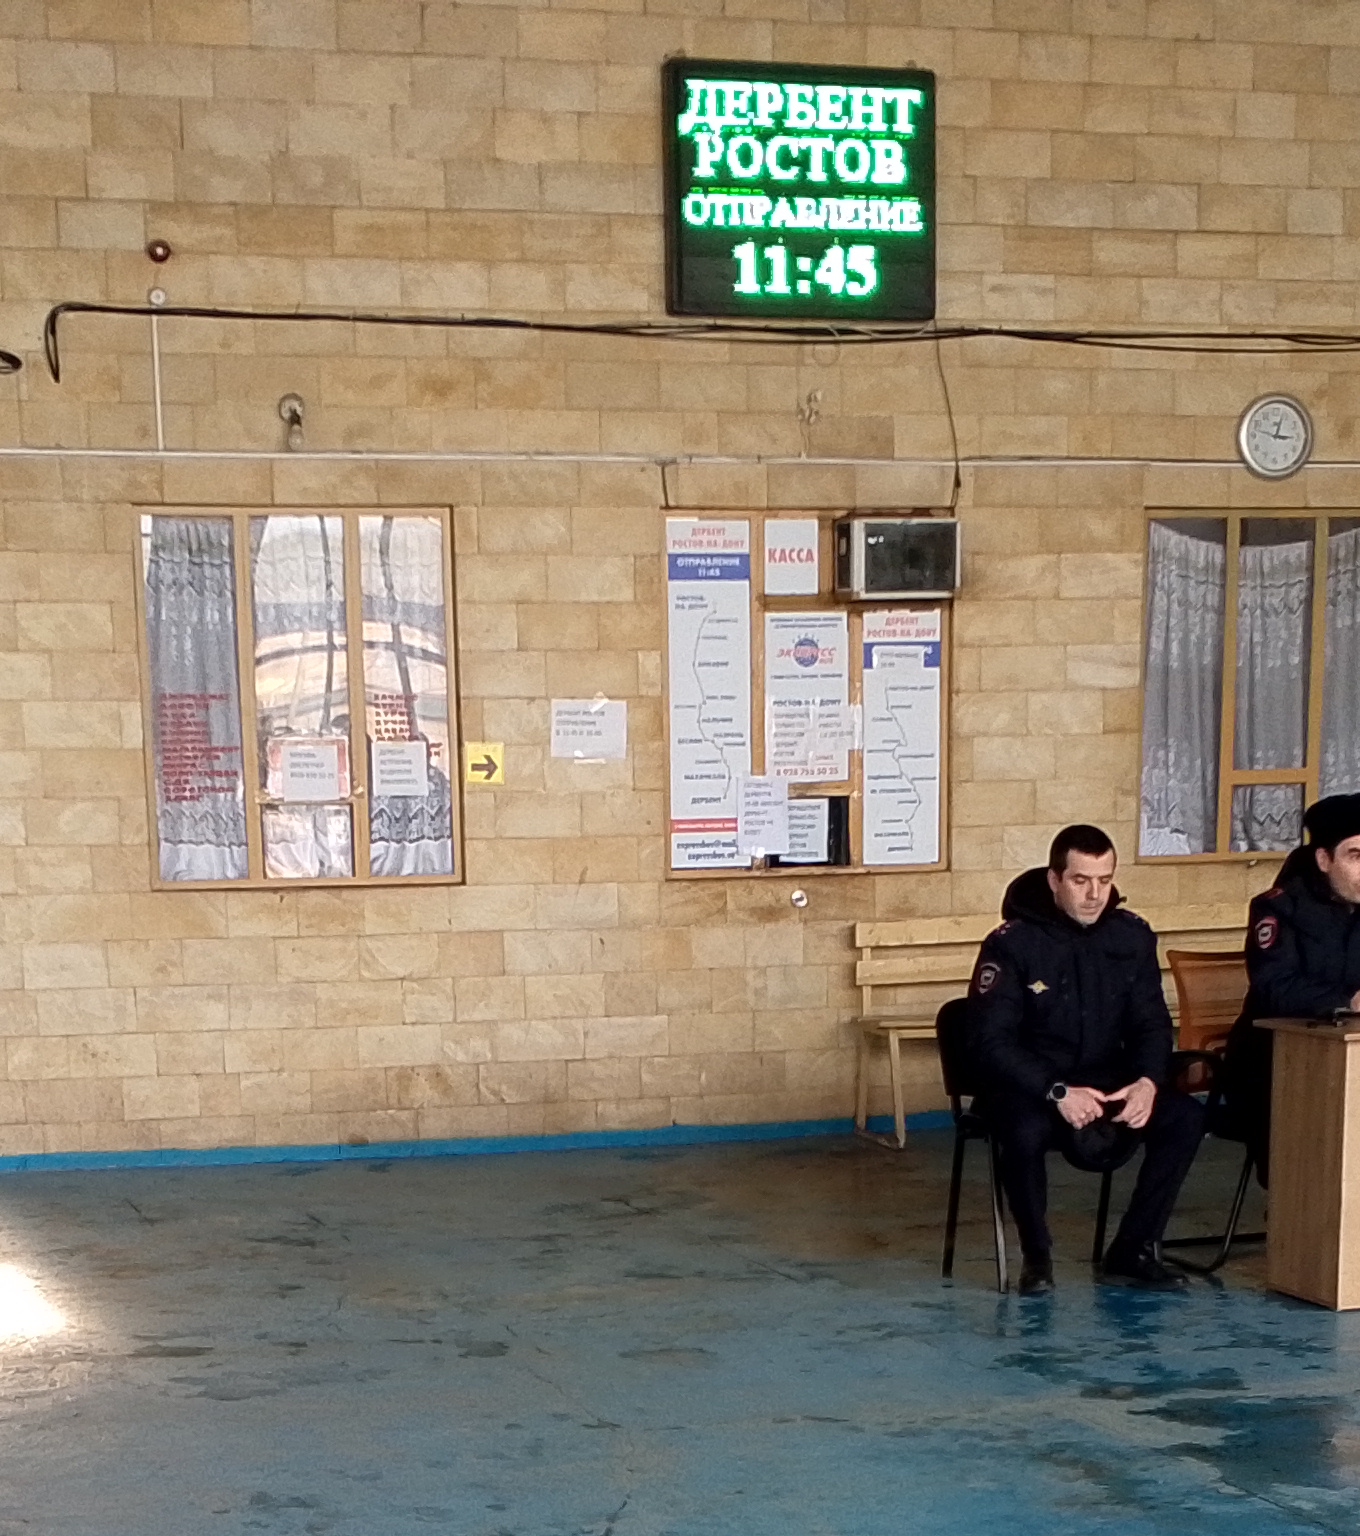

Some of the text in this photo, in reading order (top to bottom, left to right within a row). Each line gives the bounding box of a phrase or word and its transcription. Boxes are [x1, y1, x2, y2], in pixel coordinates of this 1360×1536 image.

[678, 79, 923, 134] ДЕРБЕНТ
[692, 132, 907, 184] РОСТОВ
[682, 193, 924, 232] ОТПРАВЛЕНИЕ
[733, 240, 877, 296] 11:45
[767, 548, 815, 563] КАССА
